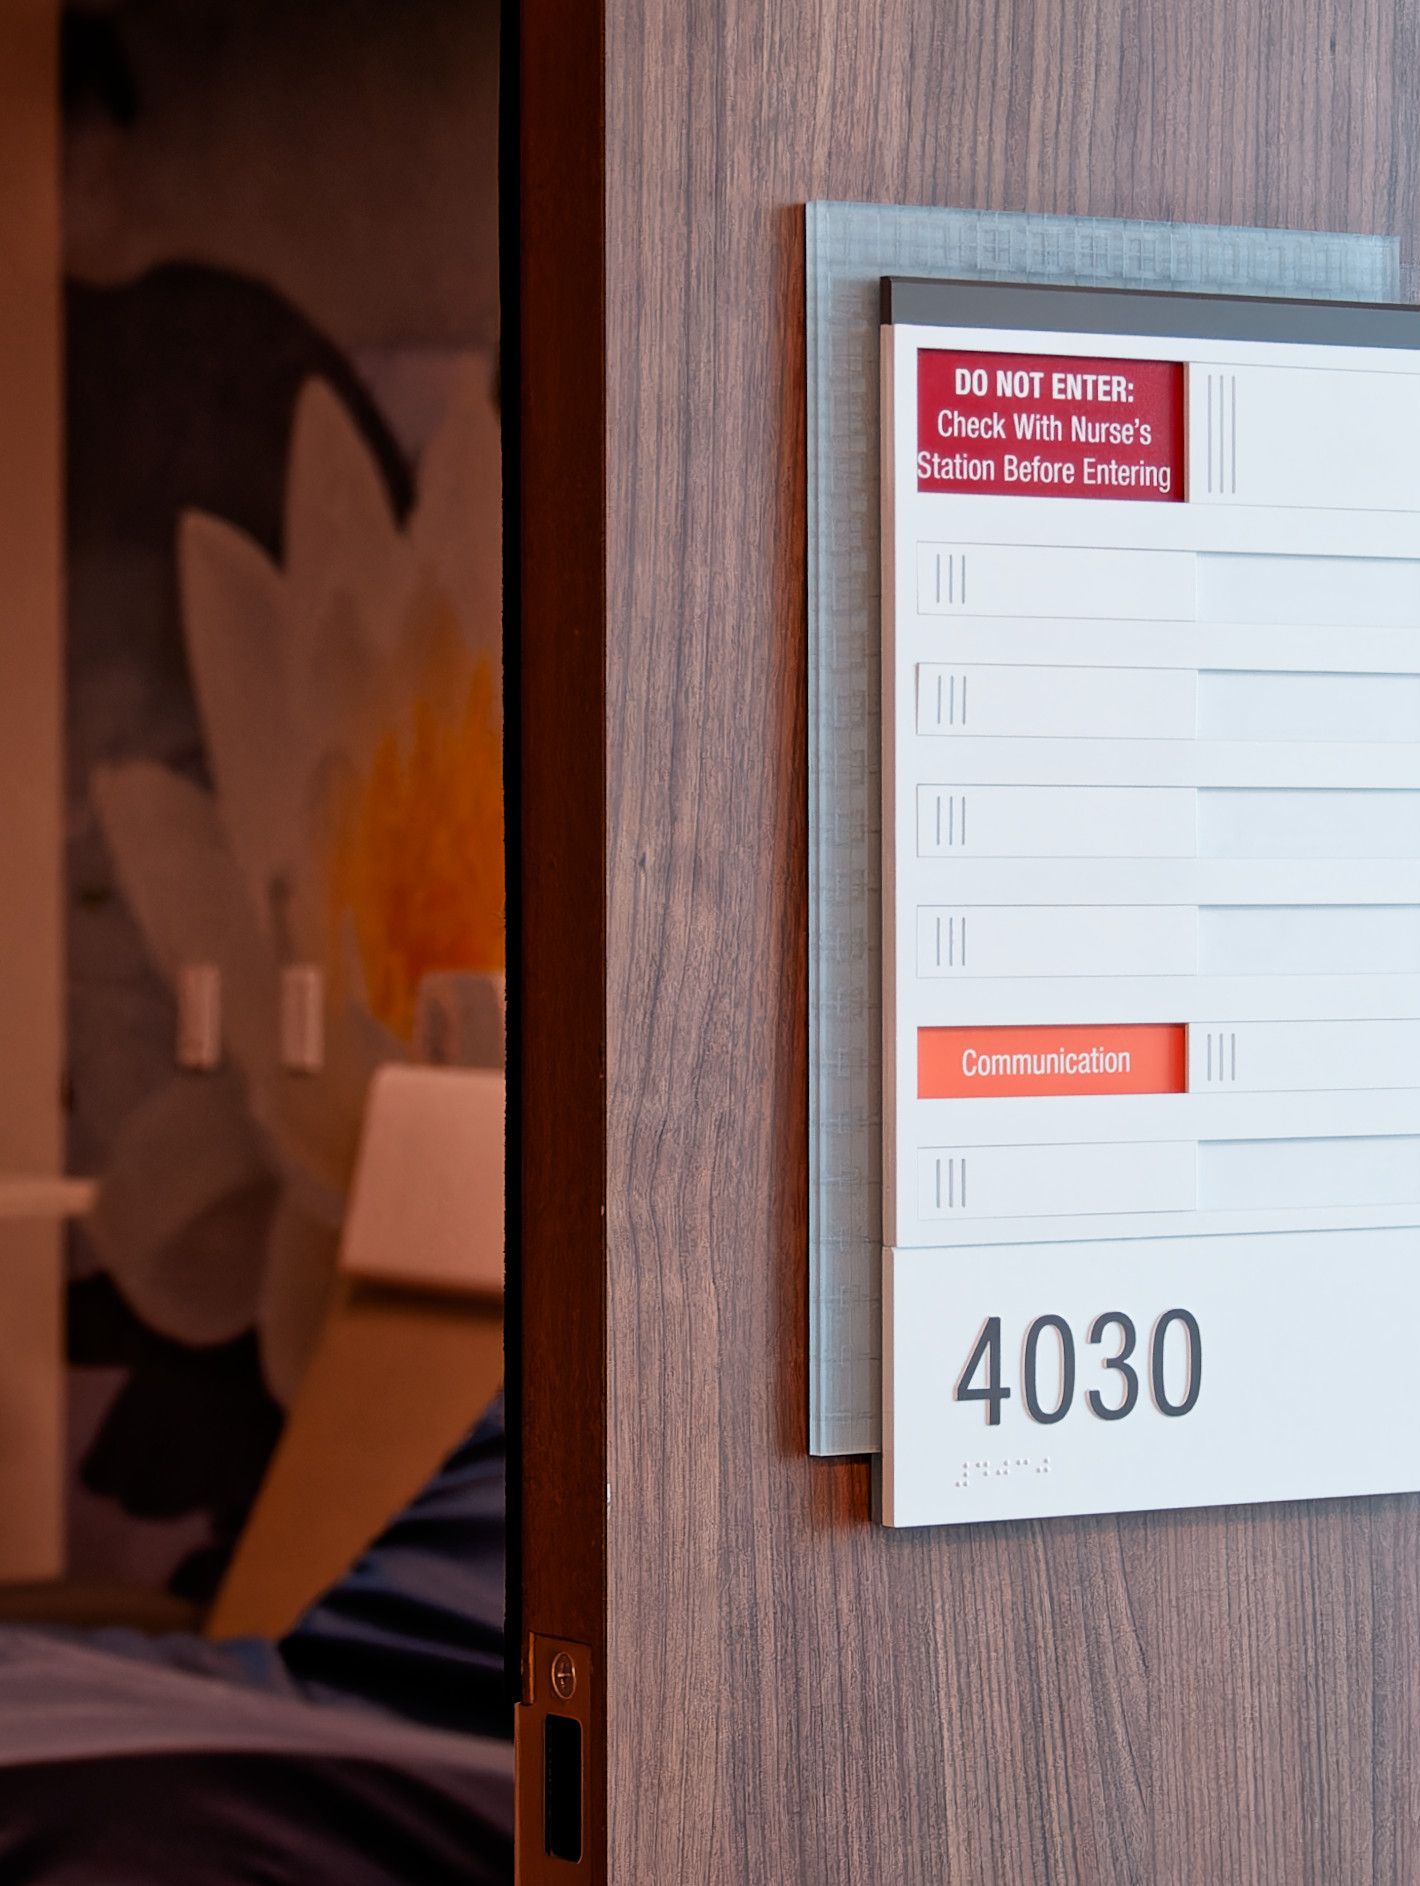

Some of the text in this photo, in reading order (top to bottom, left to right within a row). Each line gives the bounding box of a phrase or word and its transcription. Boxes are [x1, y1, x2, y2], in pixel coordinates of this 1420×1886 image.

[955, 368, 1134, 403] DO NOT ENTER:
[937, 409, 1152, 446] Check With Nurse’s
[917, 451, 1172, 493] Station Before Entering
[962, 1046, 1131, 1077] Communication
[952, 1308, 1202, 1426] 4030
